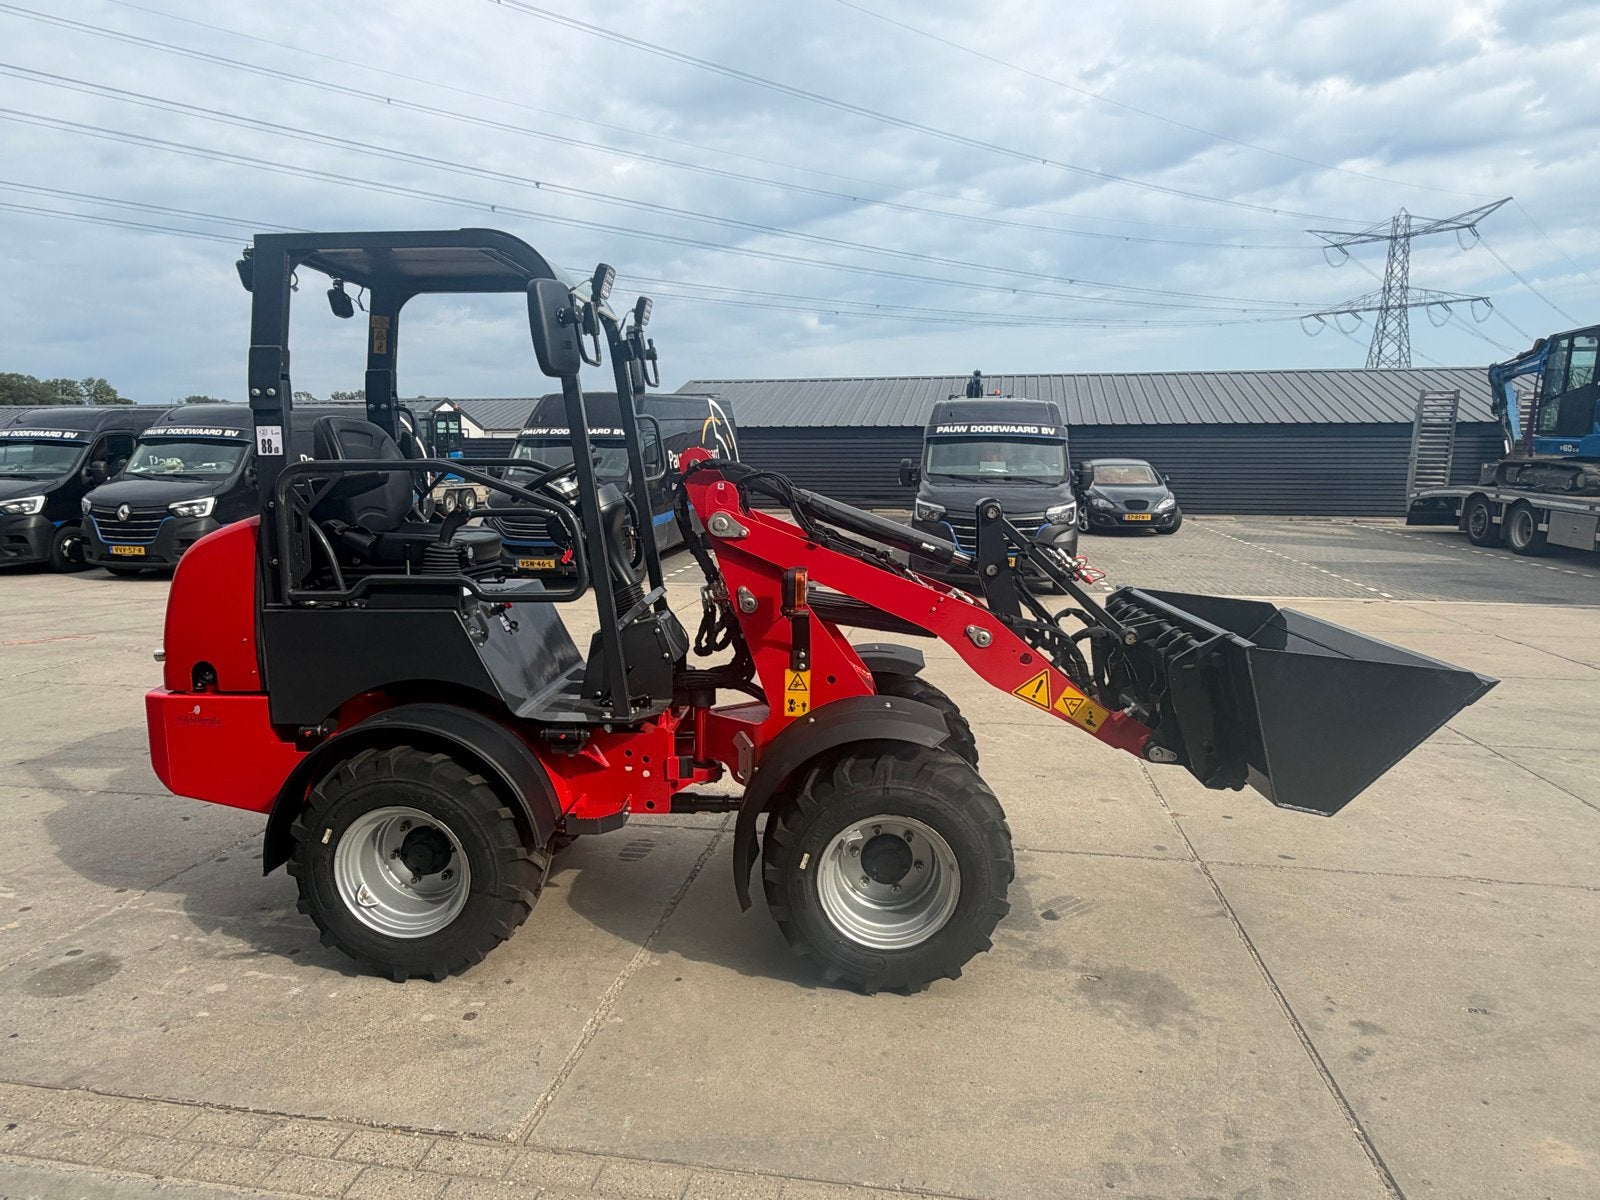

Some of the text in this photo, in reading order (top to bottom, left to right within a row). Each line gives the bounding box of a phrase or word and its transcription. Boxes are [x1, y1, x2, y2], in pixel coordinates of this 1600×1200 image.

[10, 430, 63, 438] DODEWAARD
[63, 431, 78, 439] BV
[166, 428, 222, 436] DODEWAARD
[223, 429, 239, 437] BV
[521, 428, 550, 436] PAUW
[936, 425, 1055, 435] PAUW DODEWAARD BV
[261, 438, 273, 454] 88
[520, 560, 553, 568] VSN-46-L
